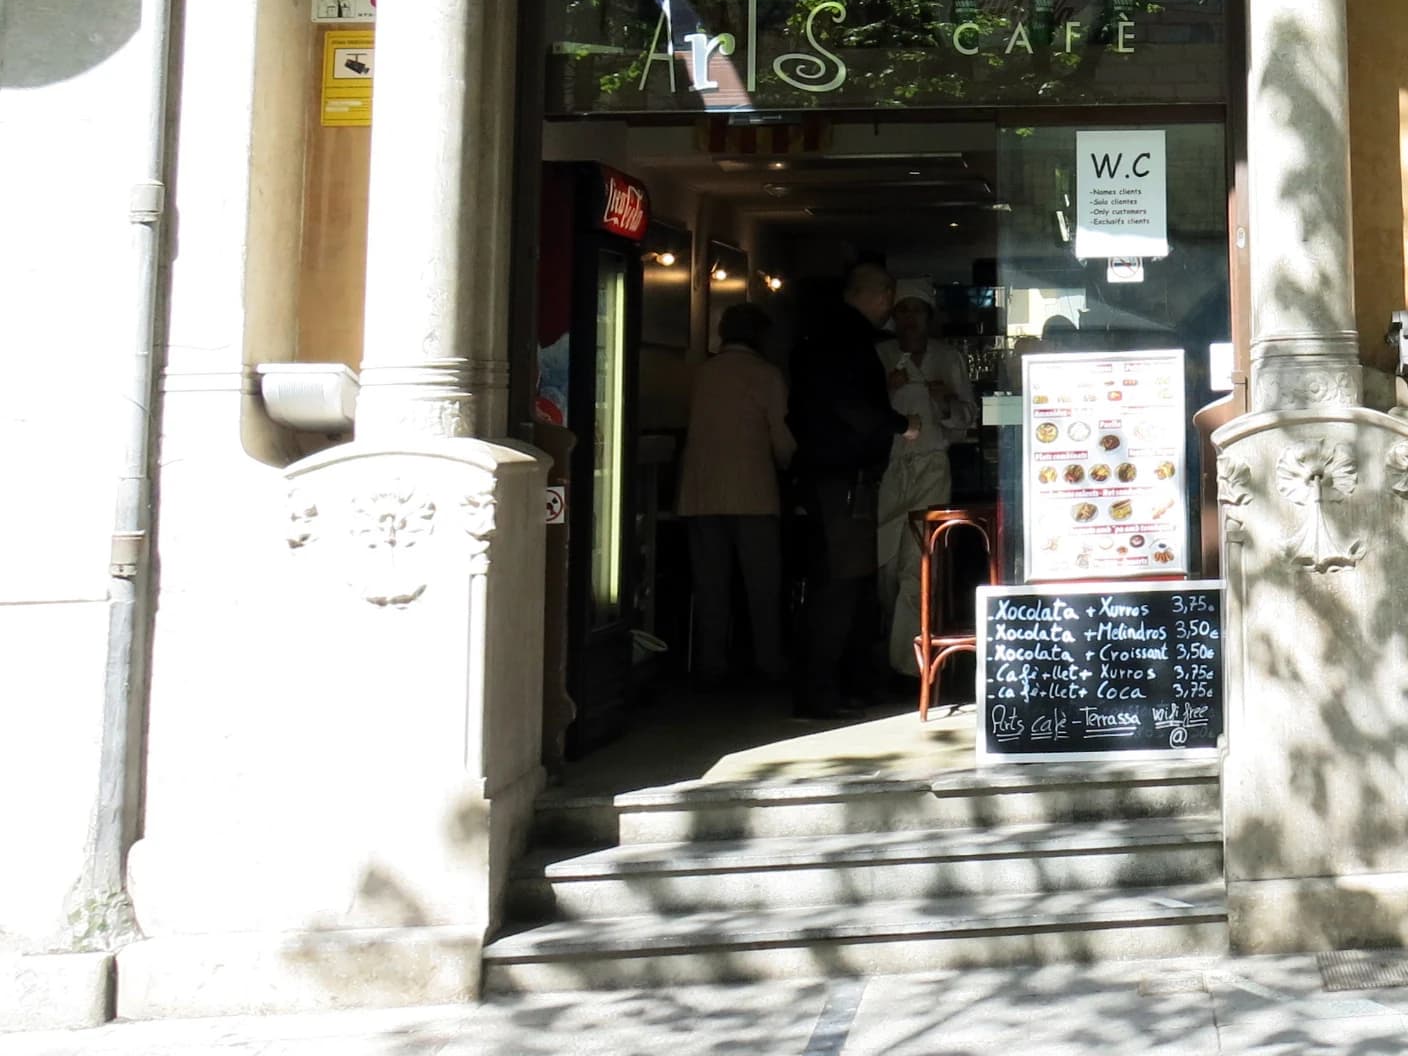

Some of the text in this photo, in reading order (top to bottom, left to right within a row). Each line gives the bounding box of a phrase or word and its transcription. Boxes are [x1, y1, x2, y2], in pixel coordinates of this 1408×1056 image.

[952, 12, 1136, 56] CAFÈ
[1127, 217, 1150, 225] clients
[1098, 596, 1150, 618] Xurros
[1099, 642, 1168, 661] Croissant
[1100, 663, 1156, 680] Xurros
[1097, 680, 1147, 699] Coca
[1080, 707, 1141, 728] Terrassa
